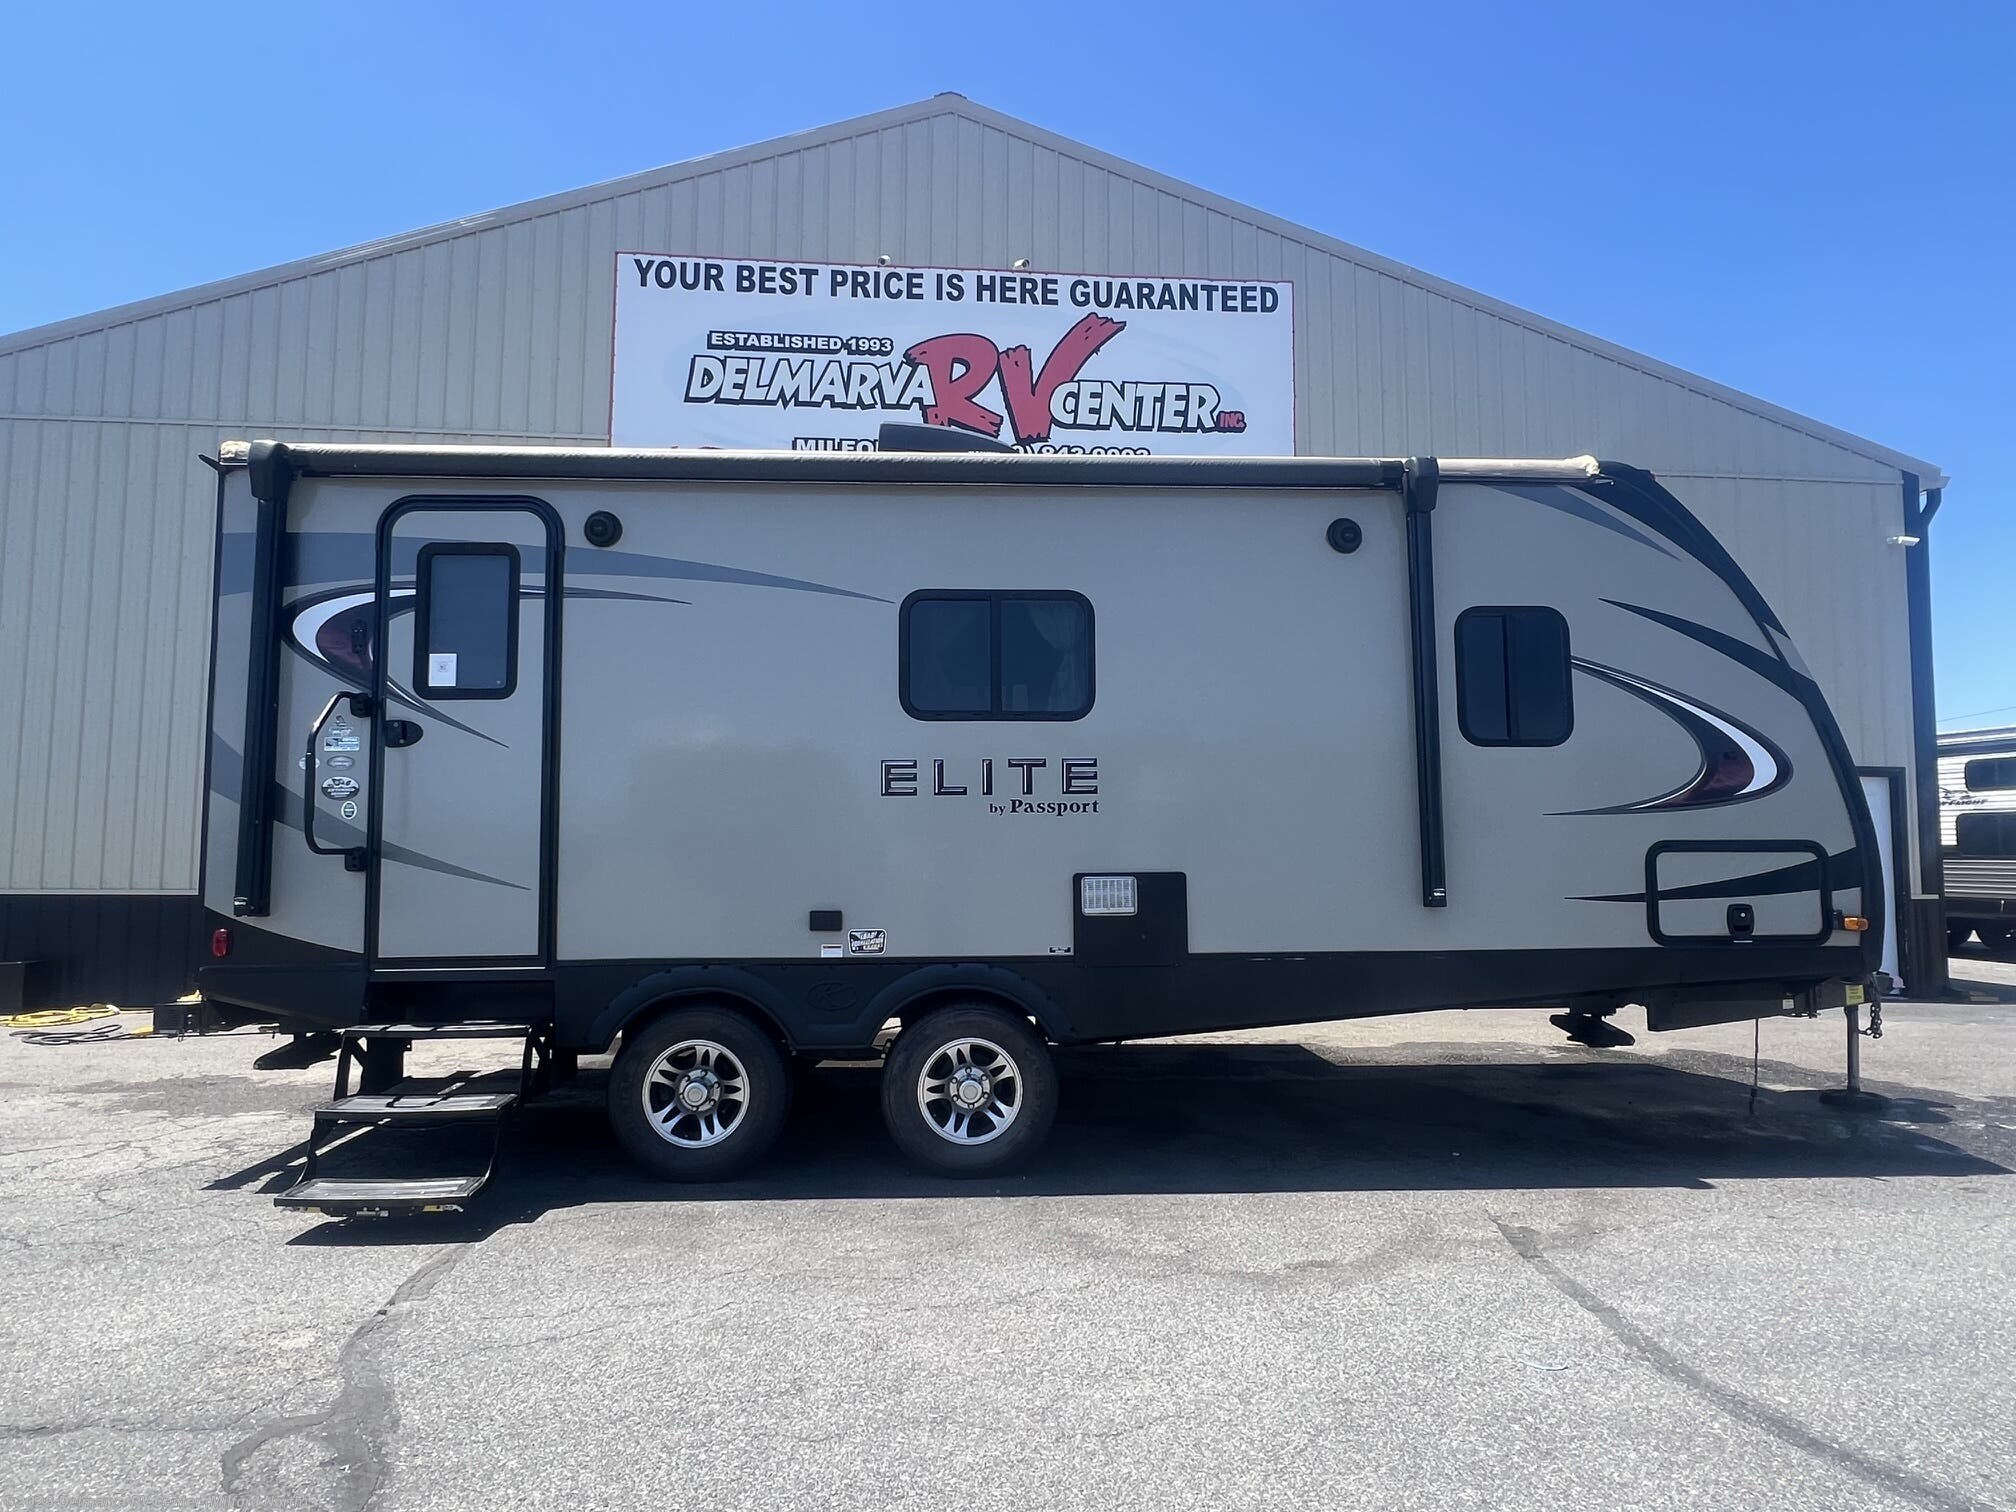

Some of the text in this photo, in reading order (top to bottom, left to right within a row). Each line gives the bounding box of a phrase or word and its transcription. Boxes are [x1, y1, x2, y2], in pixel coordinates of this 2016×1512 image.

[633, 259, 1279, 313] YOUR BEST PRICE IS HERE GUARANTEED
[709, 331, 893, 355] ESTABLISHED 1993
[684, 312, 1248, 443] DELMARVA RV CENTER INC.
[880, 758, 1099, 797] ELITE
[989, 798, 1100, 817] by Passport
